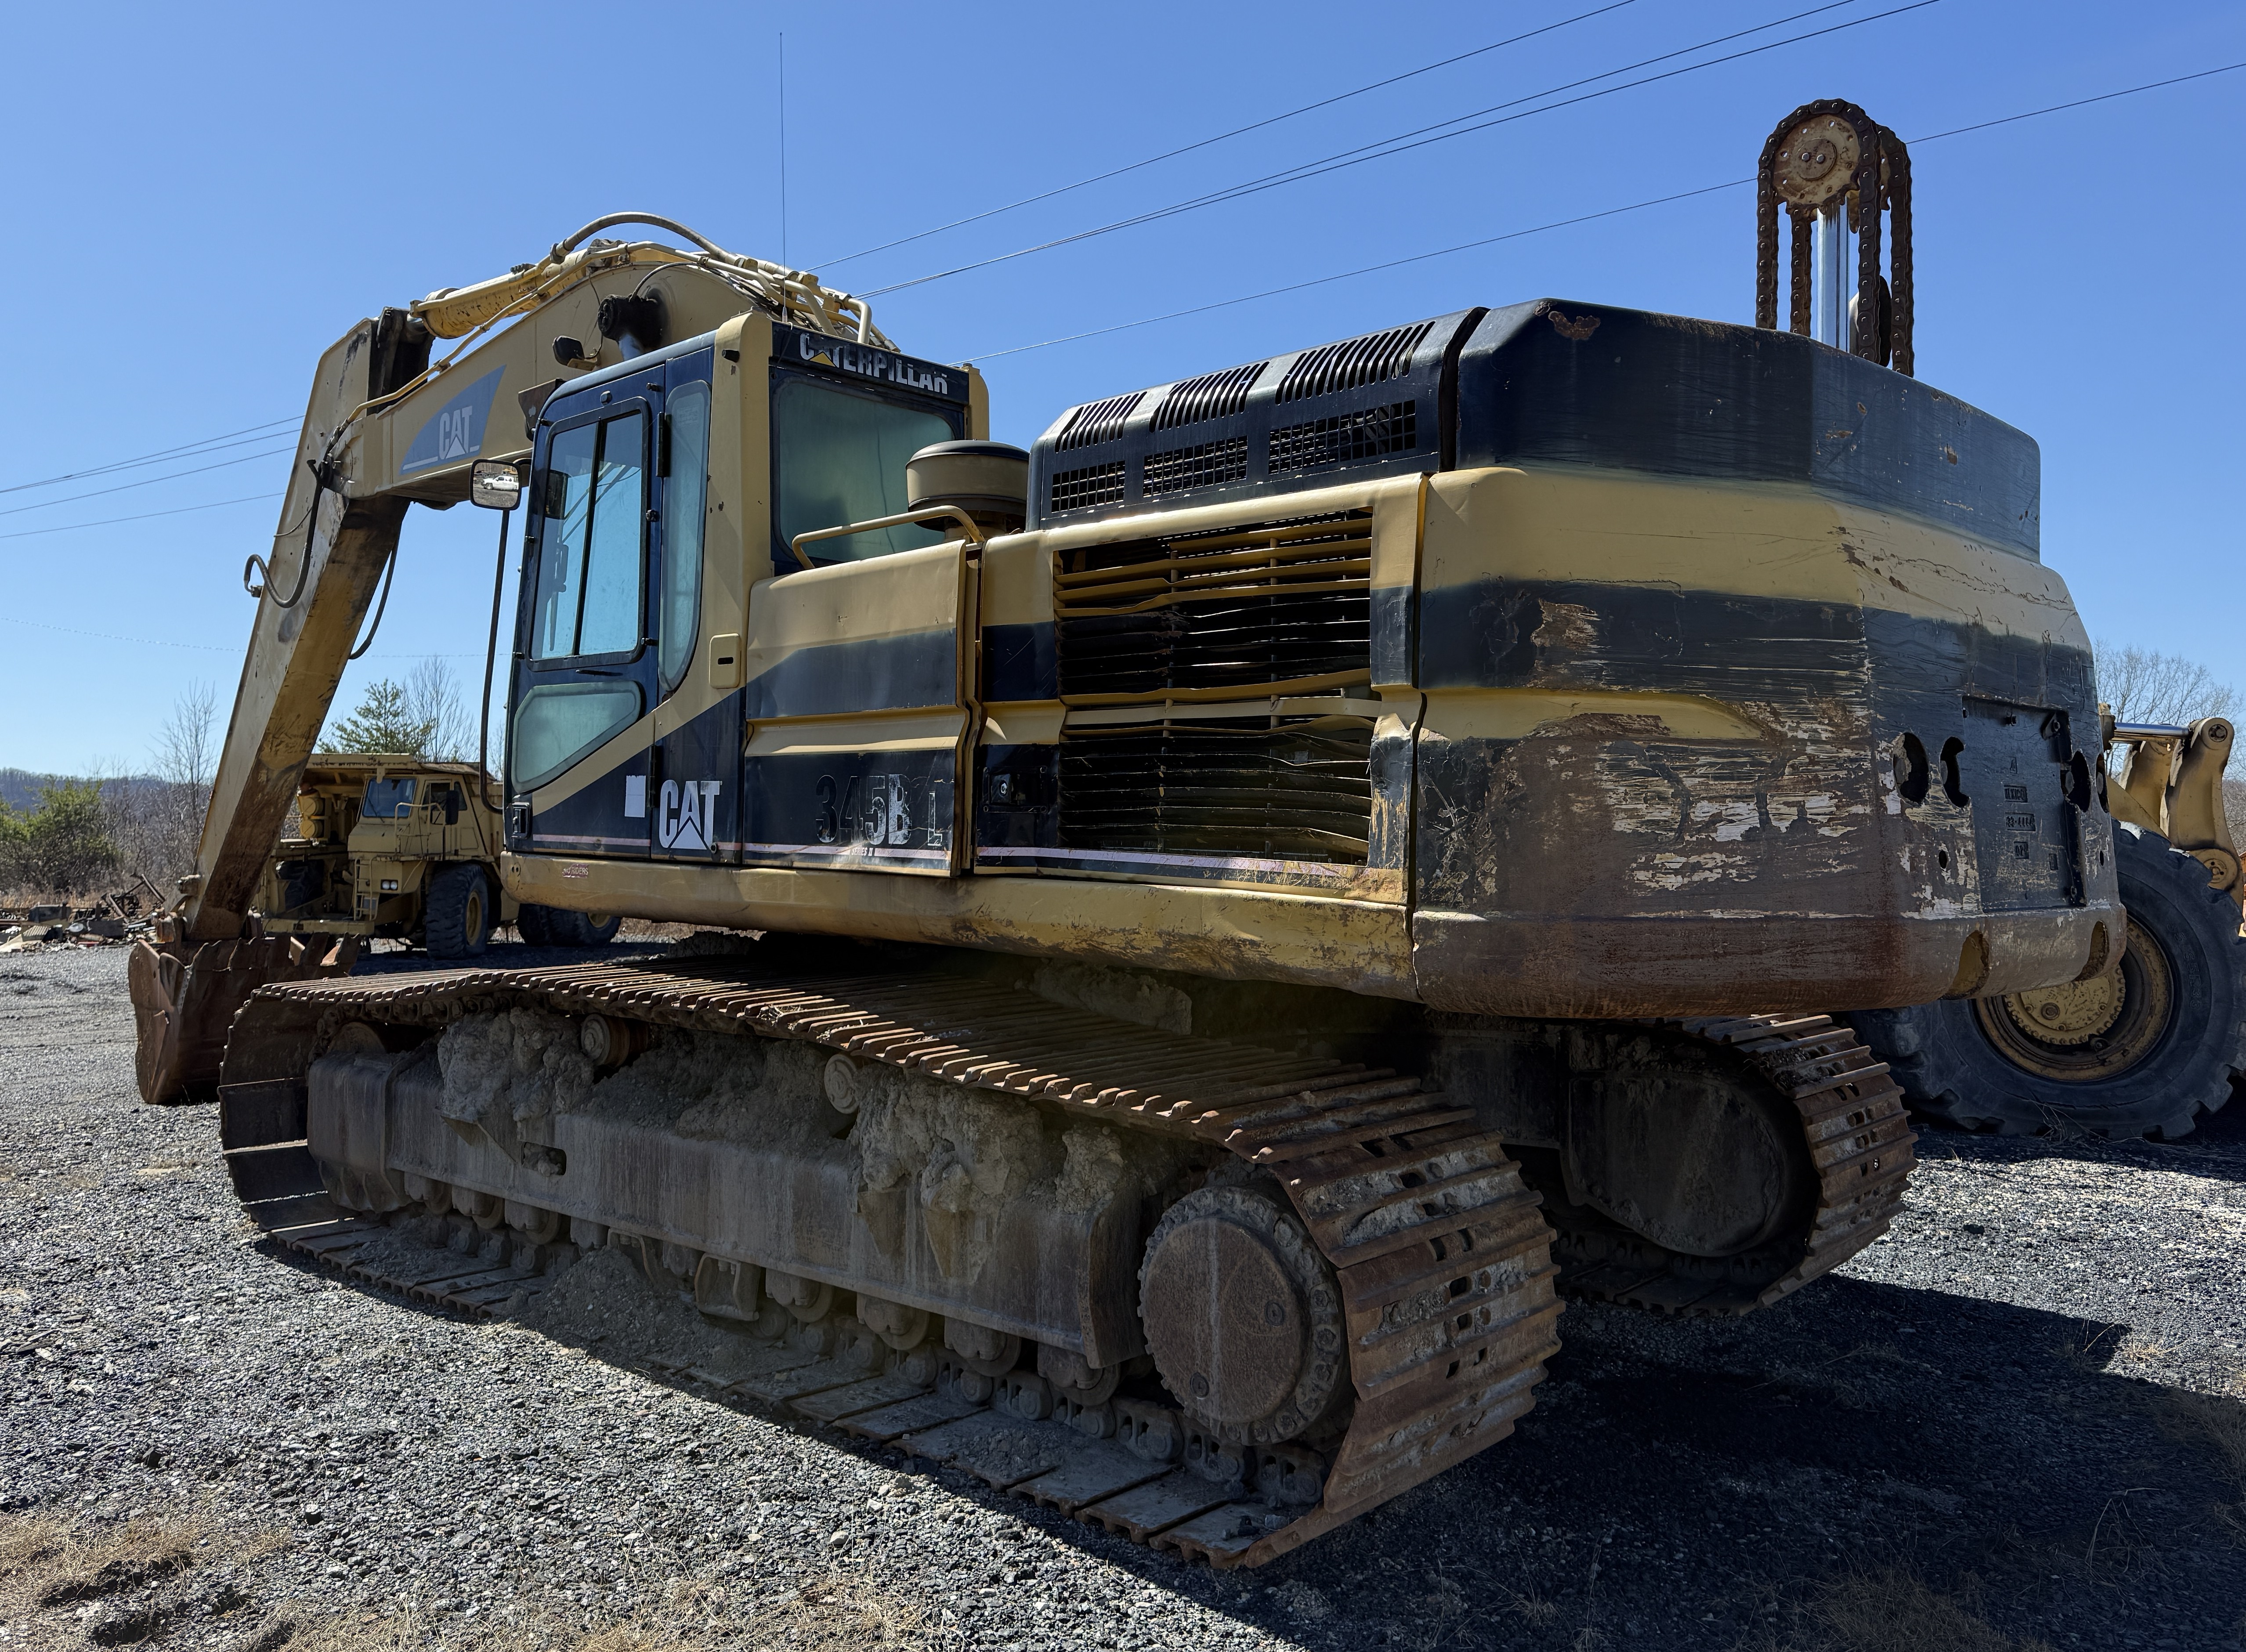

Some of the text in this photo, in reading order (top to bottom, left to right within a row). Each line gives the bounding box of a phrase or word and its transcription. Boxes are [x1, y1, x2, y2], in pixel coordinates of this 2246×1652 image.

[439, 405, 473, 460] CAT
[659, 779, 720, 849] CAT
[815, 774, 943, 846] 345B L
[851, 847, 868, 856] SERIES
